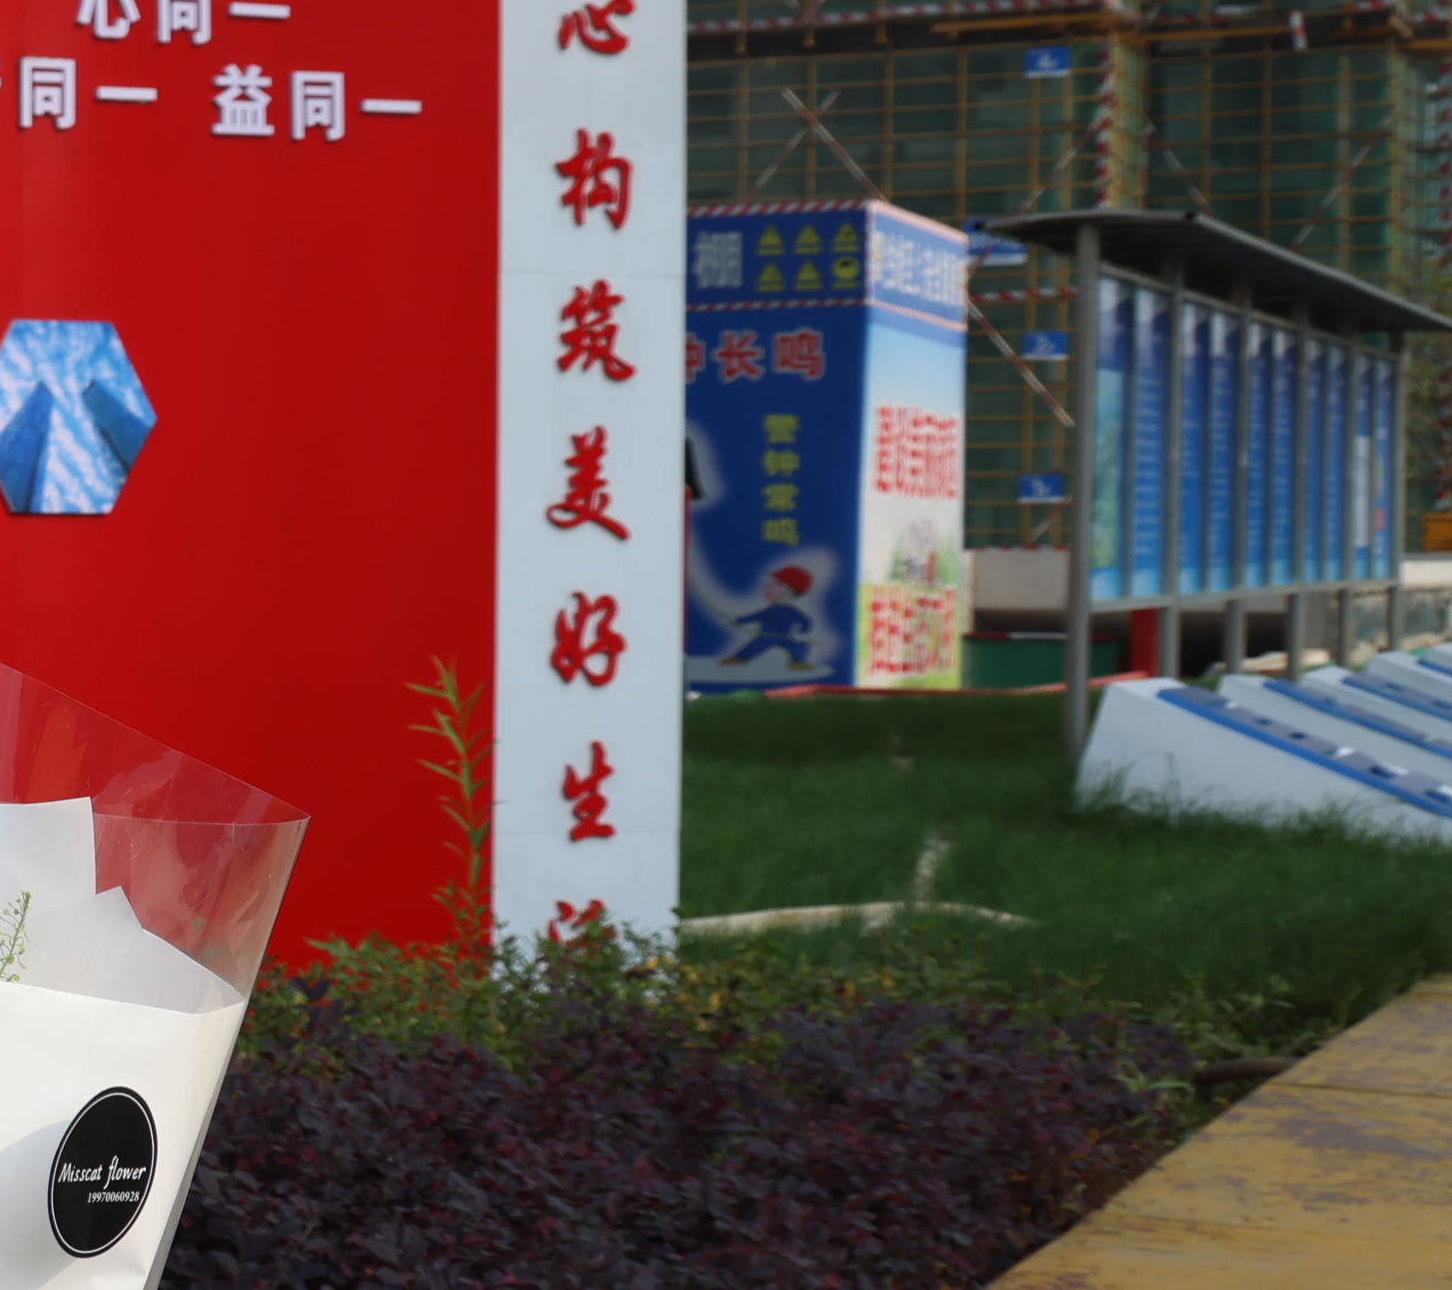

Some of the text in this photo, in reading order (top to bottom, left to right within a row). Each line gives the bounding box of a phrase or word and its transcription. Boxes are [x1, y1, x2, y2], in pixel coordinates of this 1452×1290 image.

[212, 64, 422, 141] 益同一
[58, 1156, 146, 1190] Misscat flower
[87, 1192, 141, 1204] 19970060928
